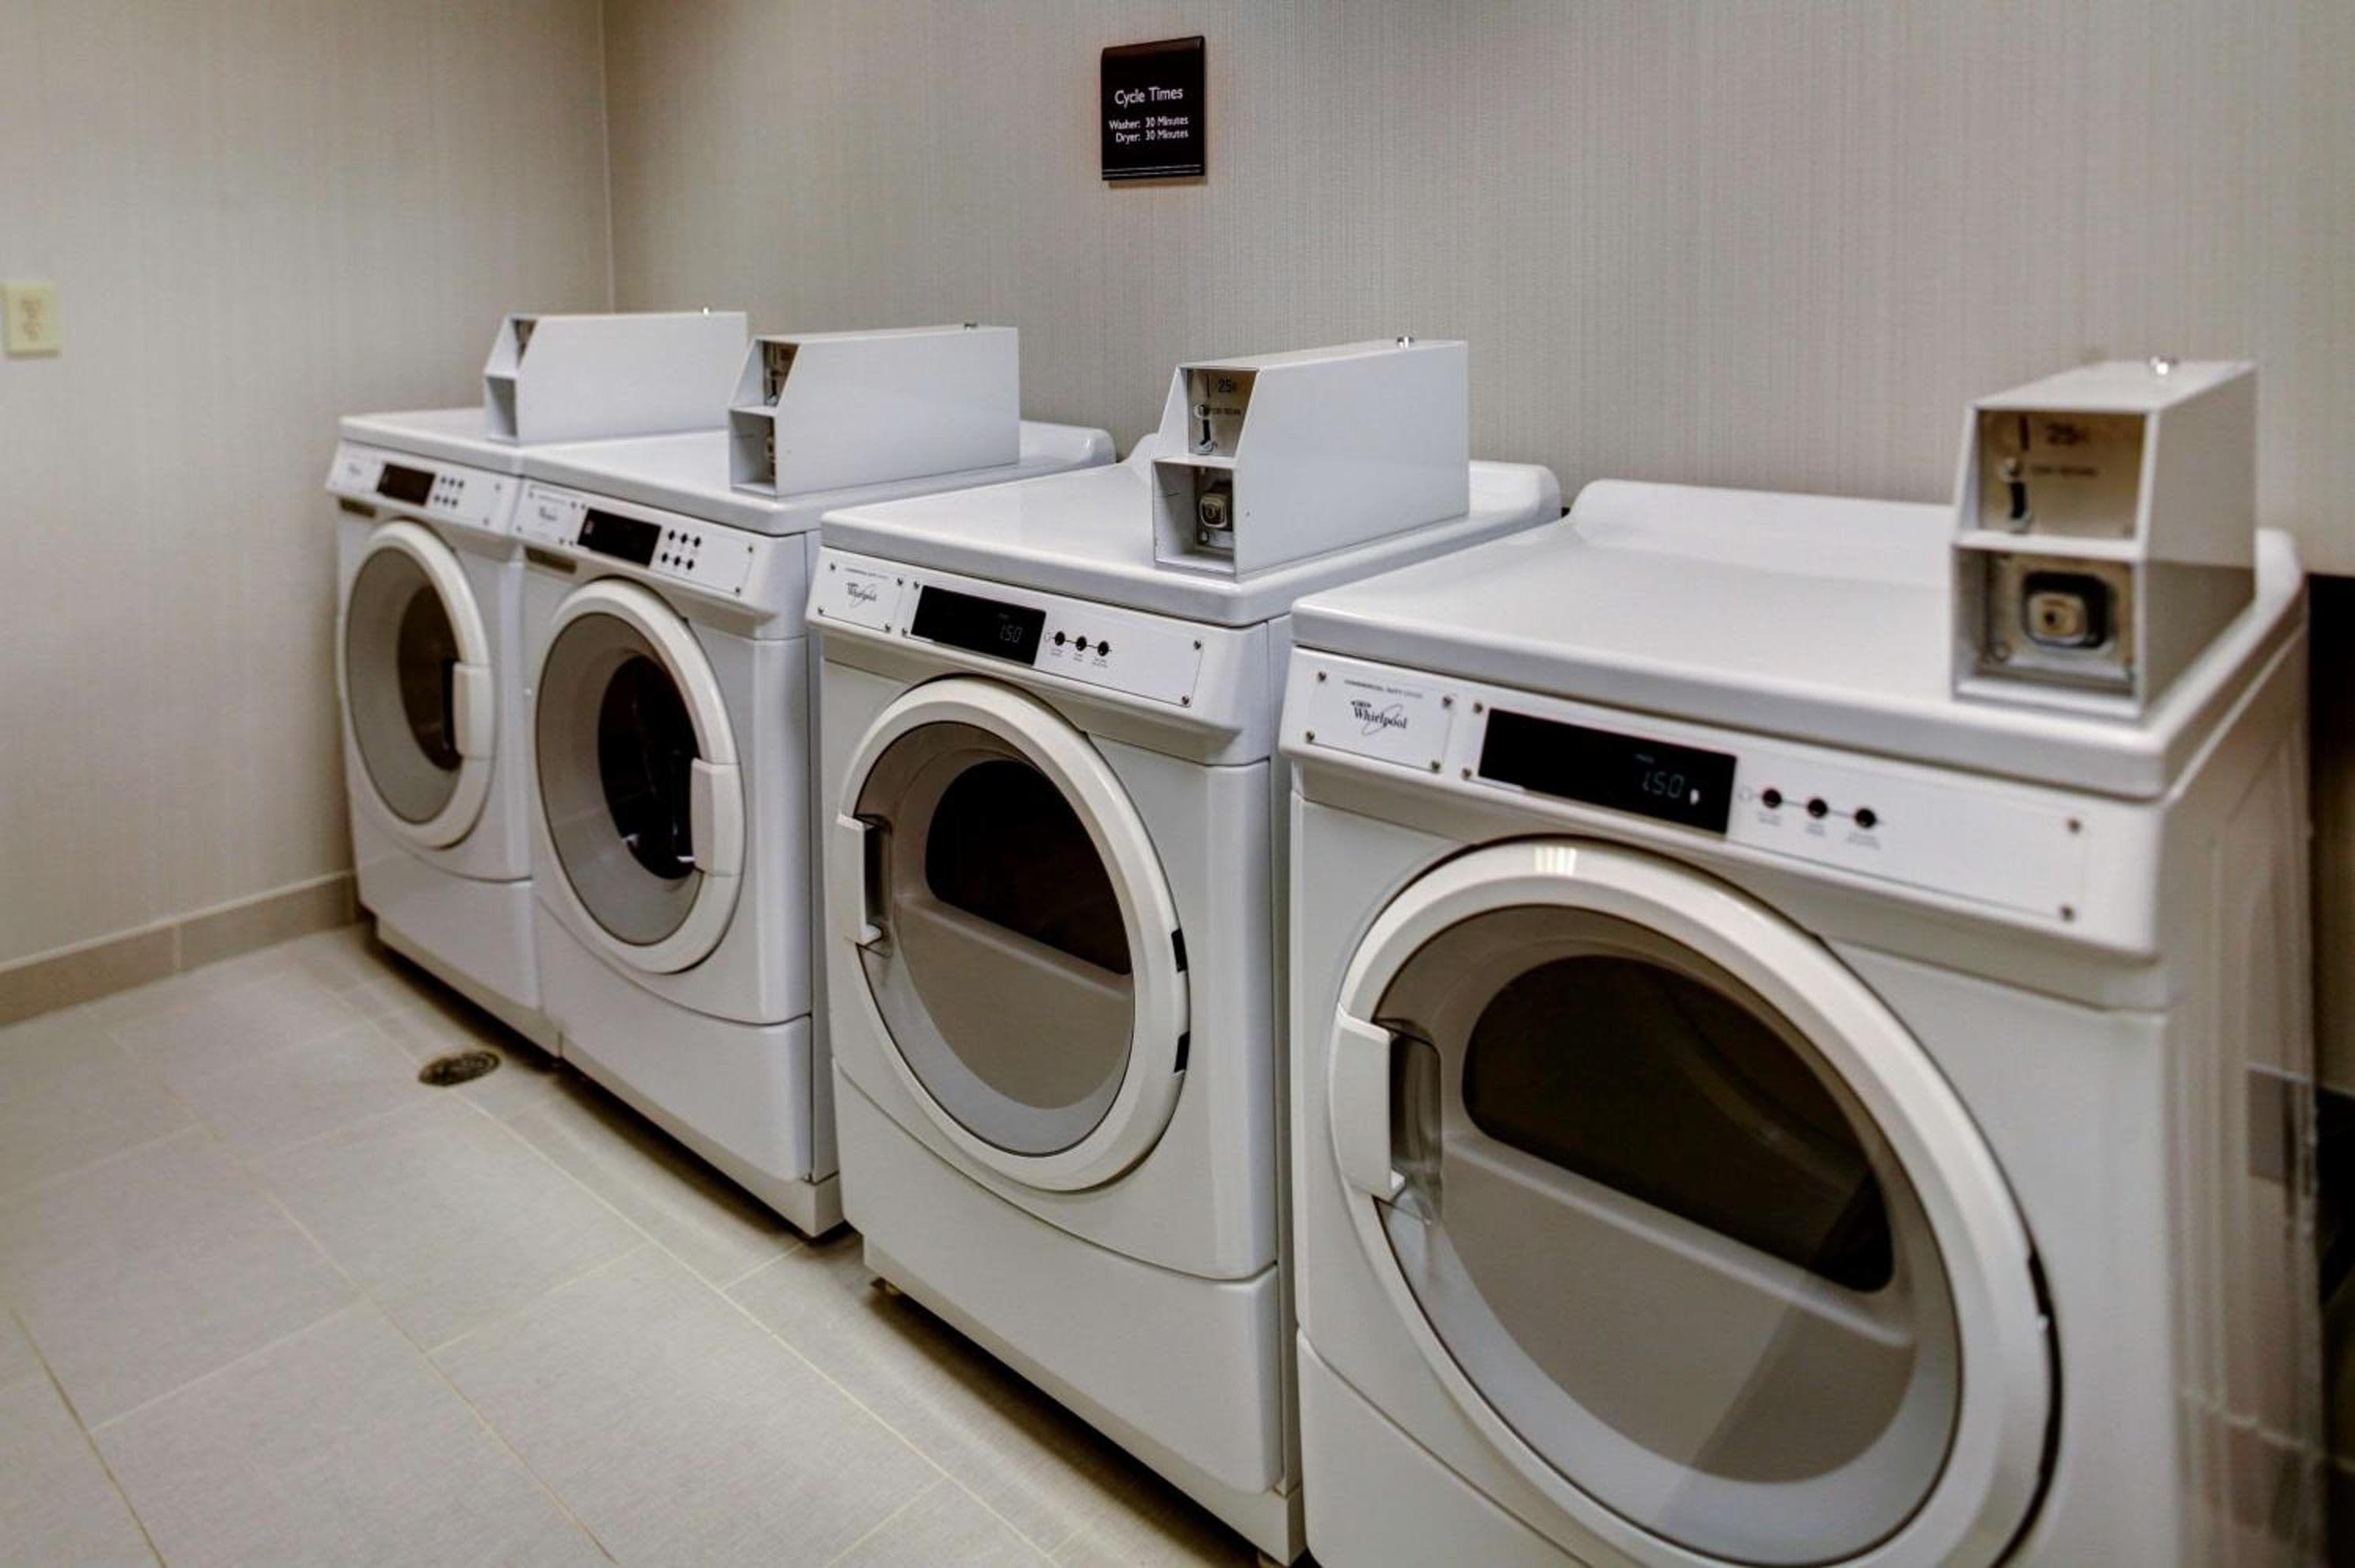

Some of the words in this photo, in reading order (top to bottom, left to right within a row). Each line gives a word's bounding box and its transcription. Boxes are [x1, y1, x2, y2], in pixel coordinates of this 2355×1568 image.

[1114, 88, 1145, 109] Cycle
[1148, 86, 1184, 102] Times
[1108, 119, 1141, 130] Washer:
[1145, 116, 1156, 128] 30
[1157, 115, 1189, 126] Minutes
[1115, 133, 1141, 144] Dryer:
[1145, 129, 1156, 140] 30
[1157, 129, 1189, 140] Minutes
[1353, 706, 1408, 729] Whirlpool
